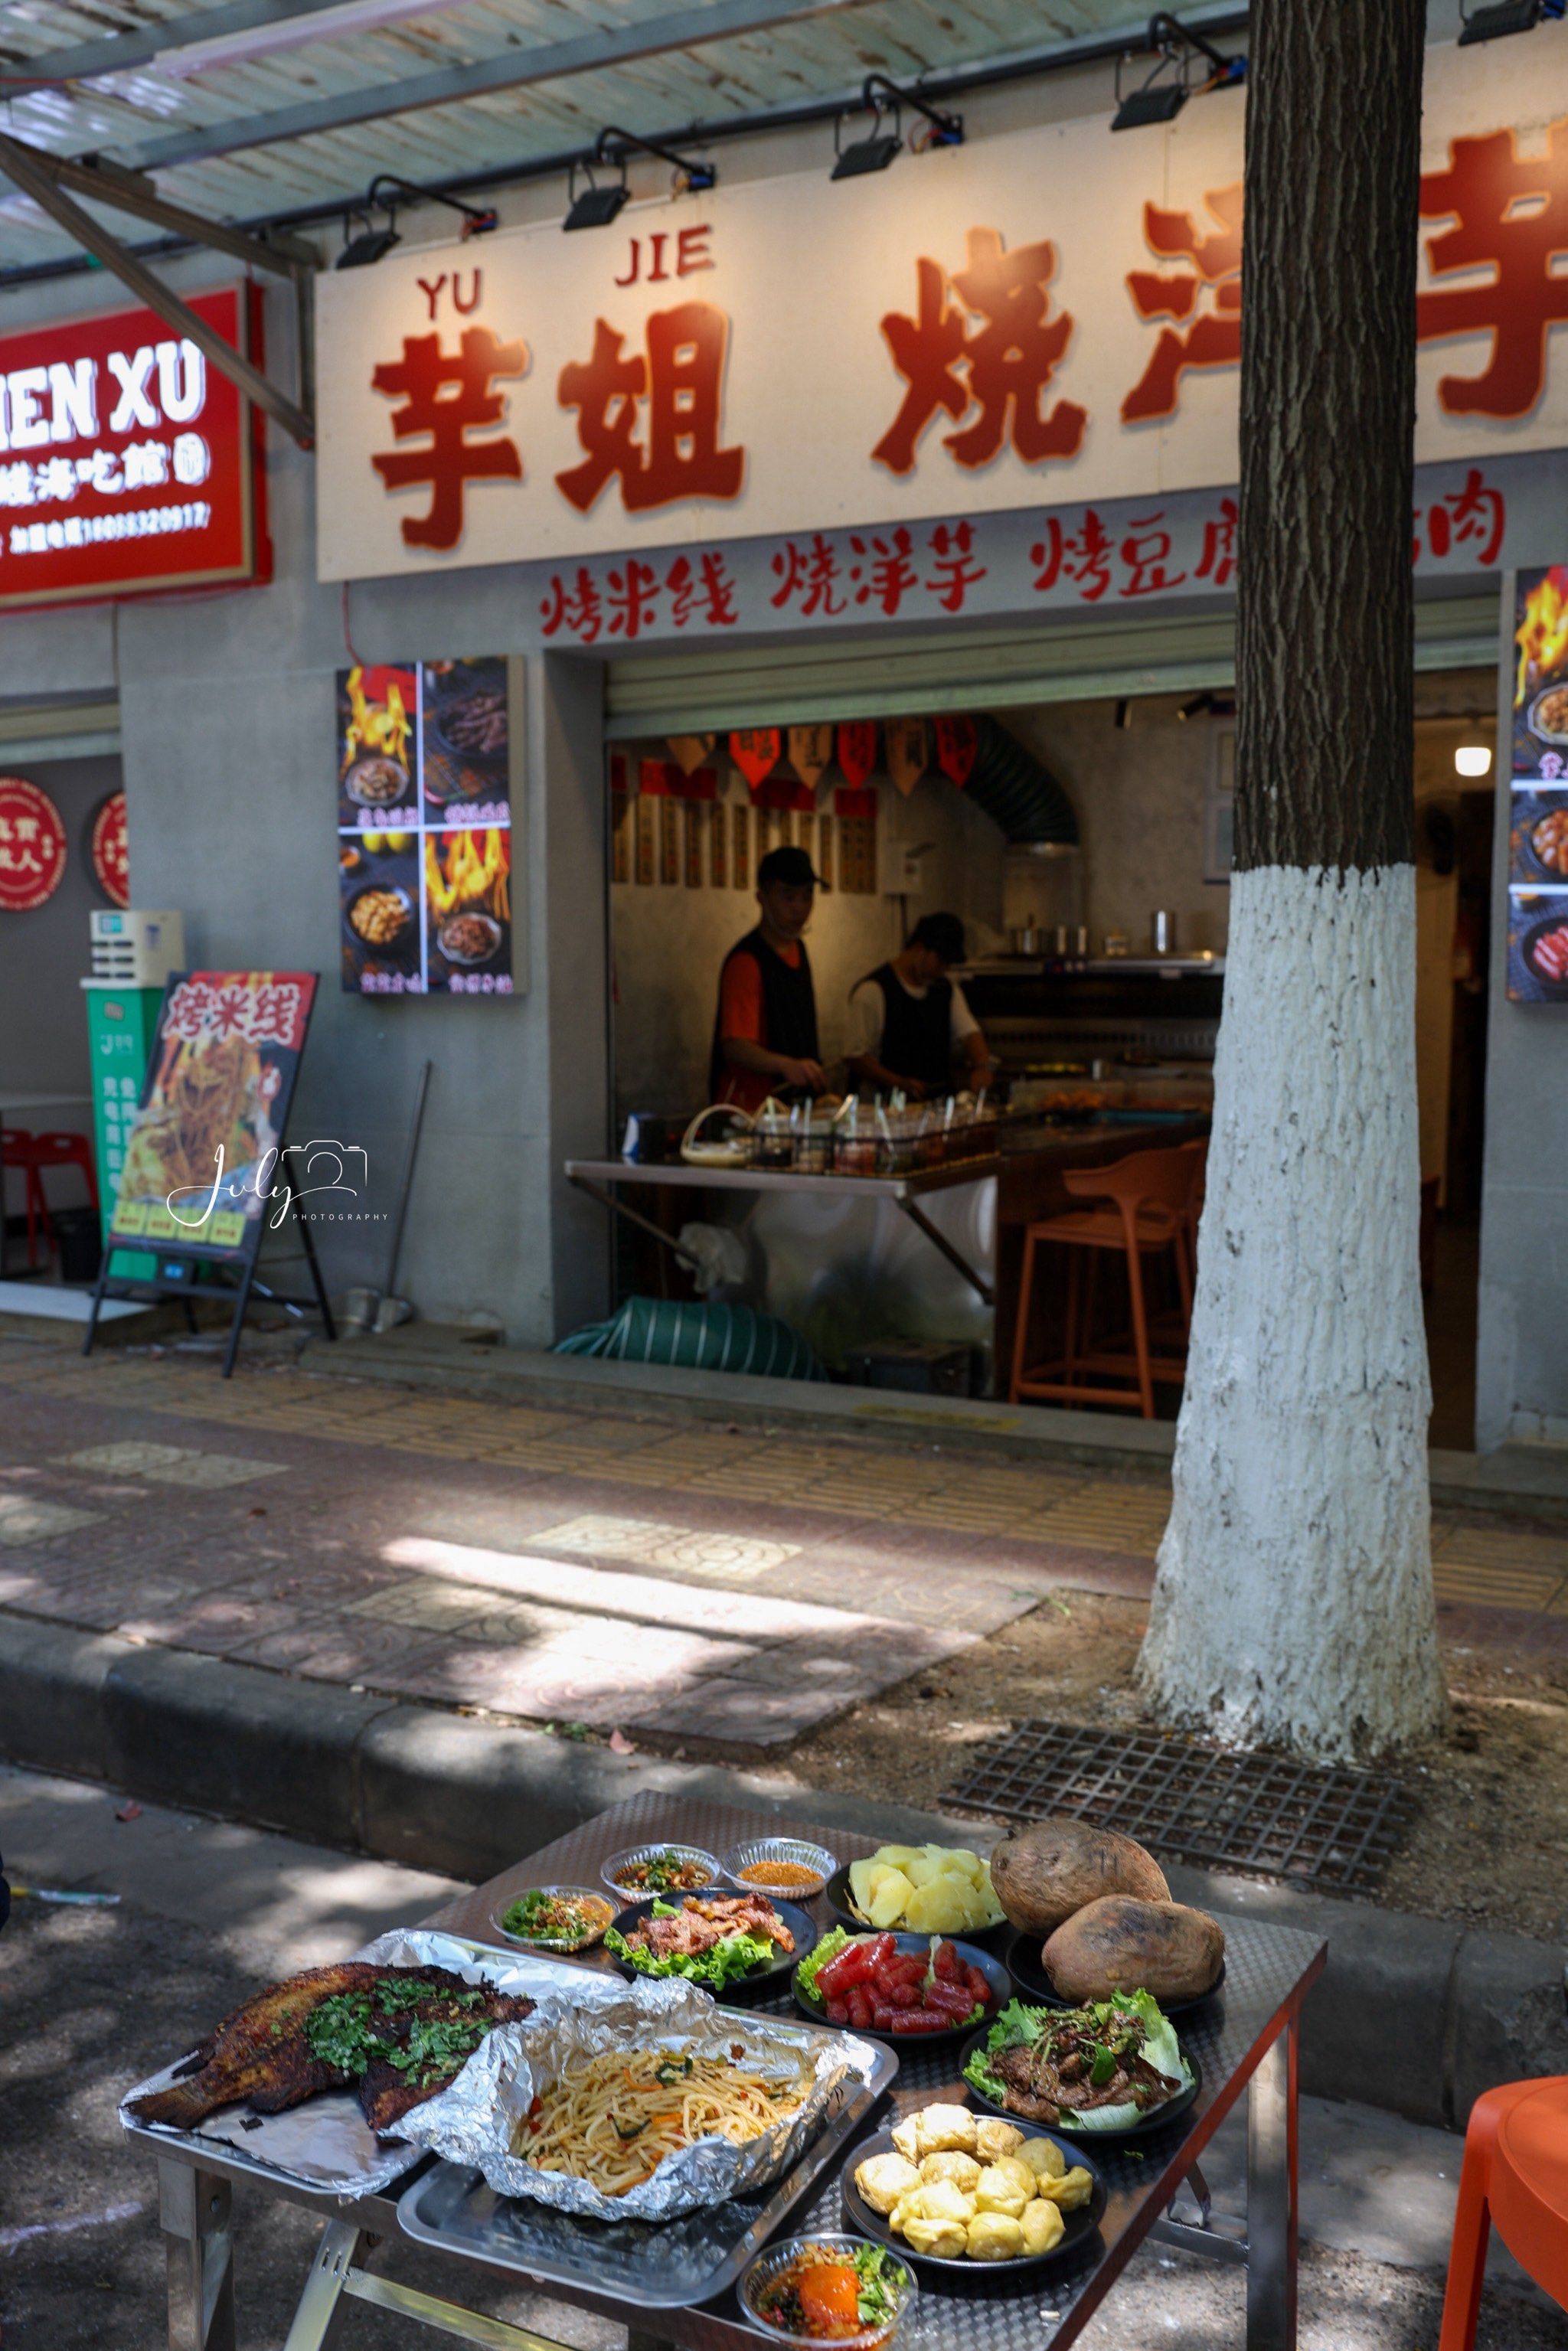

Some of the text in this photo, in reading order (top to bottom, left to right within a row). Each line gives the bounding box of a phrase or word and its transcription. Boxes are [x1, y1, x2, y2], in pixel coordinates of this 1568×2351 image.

[416, 224, 715, 321] YU JIE
[0, 338, 205, 453] EN XU
[371, 300, 746, 552] 芋姐
[540, 552, 738, 645] 烤米线
[771, 521, 987, 616] 烧洋芋
[162, 982, 299, 1045] 烤米线
